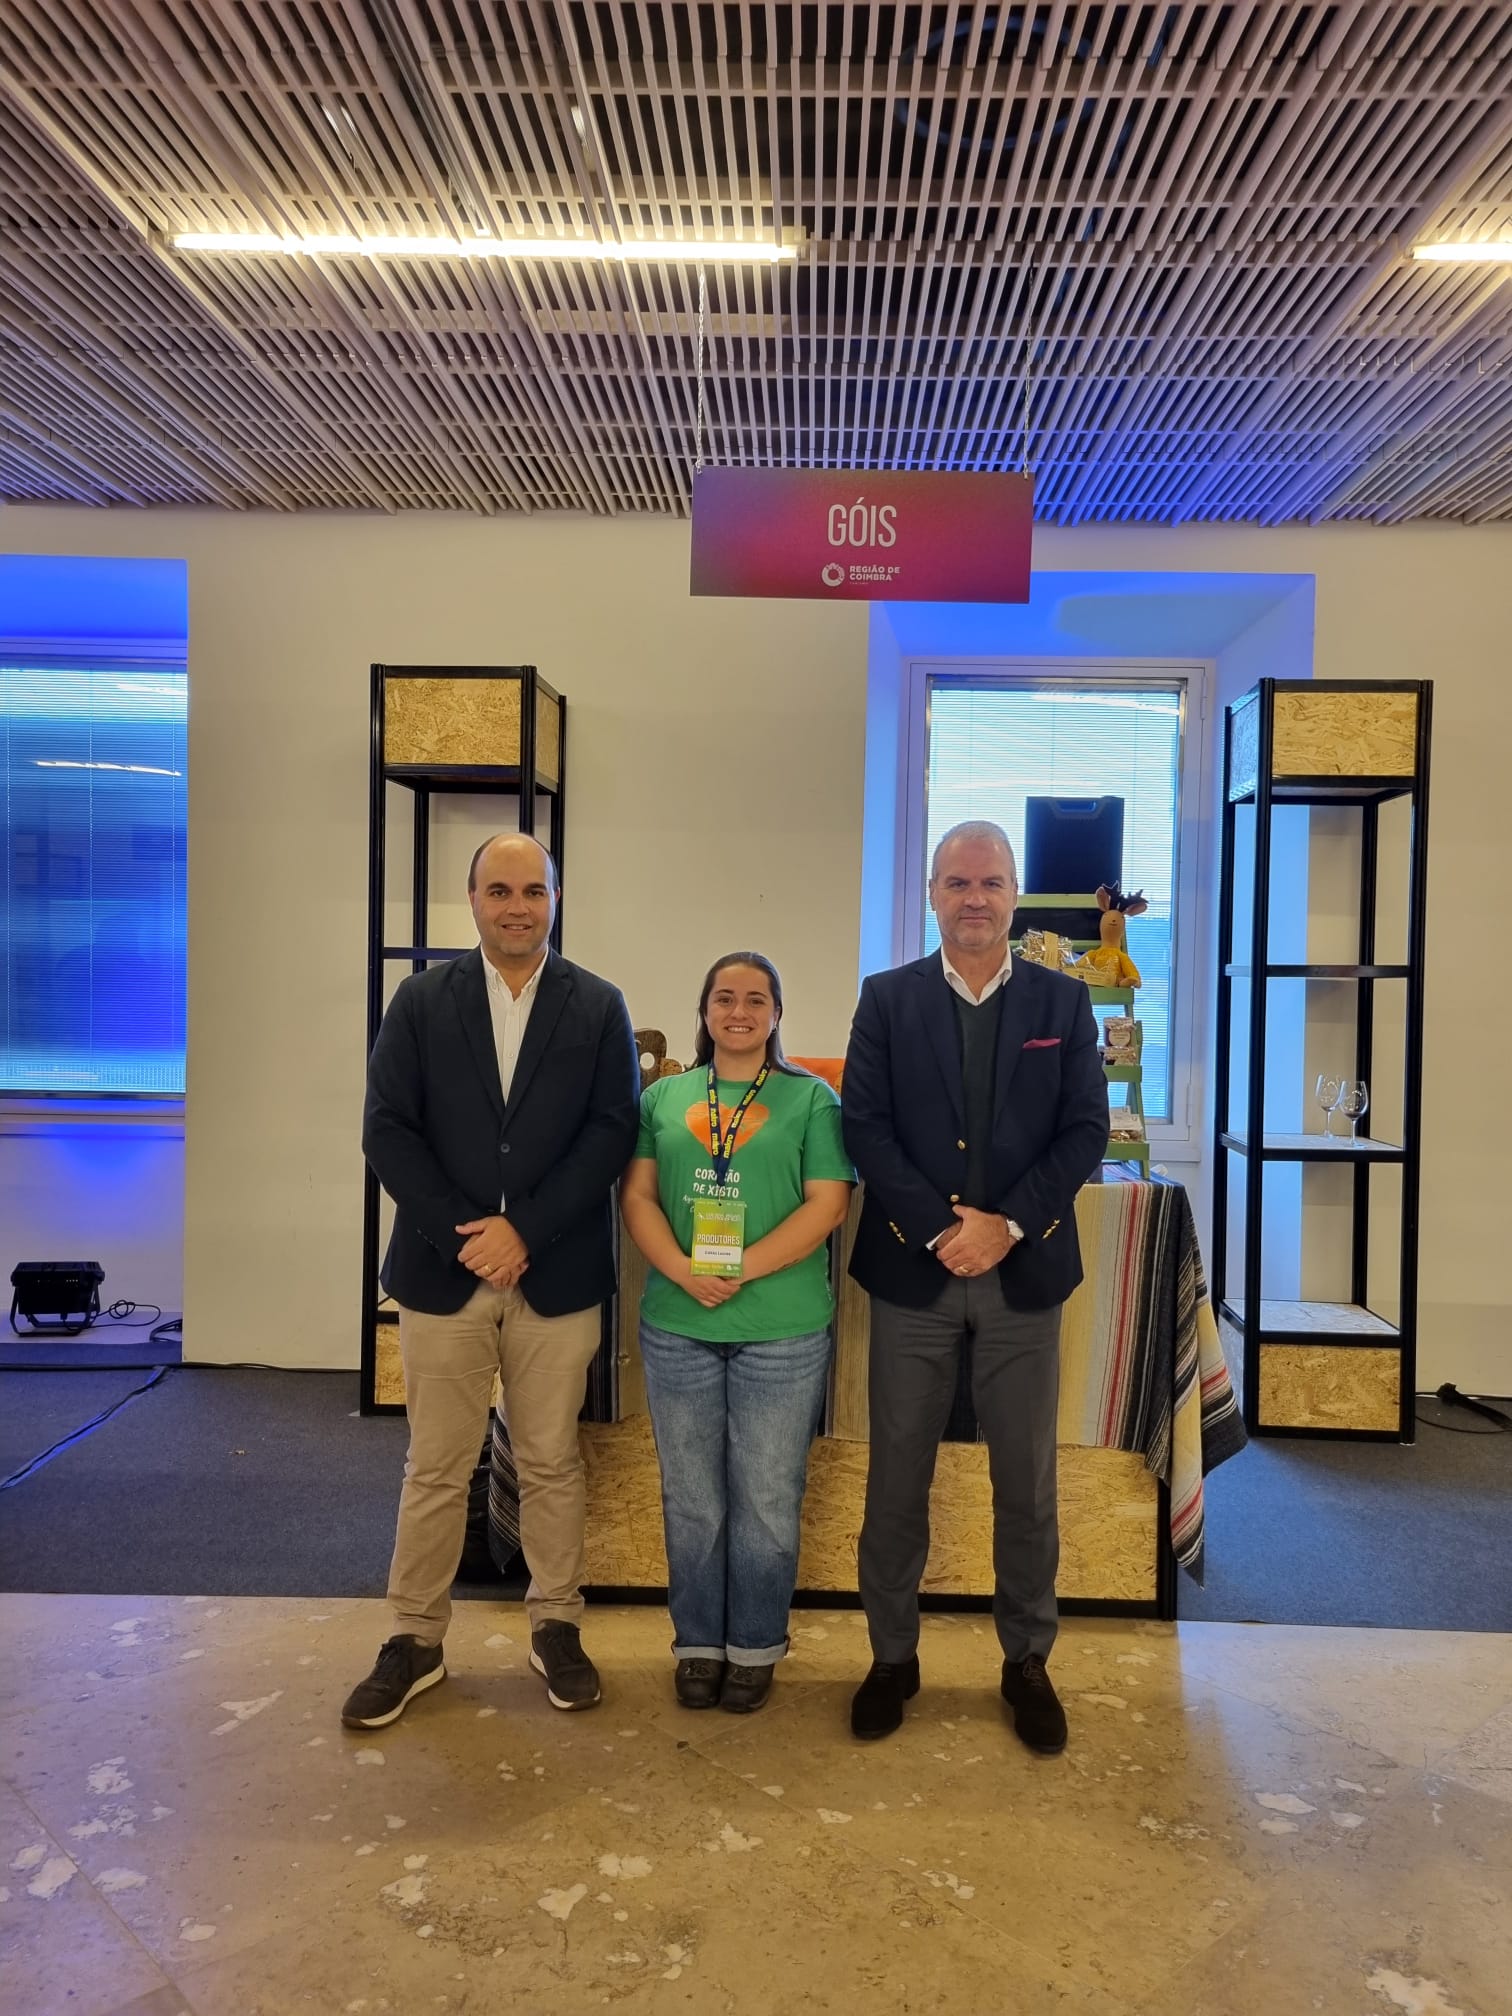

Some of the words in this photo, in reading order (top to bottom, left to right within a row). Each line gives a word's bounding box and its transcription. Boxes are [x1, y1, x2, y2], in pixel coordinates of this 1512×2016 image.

[828, 496, 897, 547] GÓIS
[849, 564, 885, 573] REGIÃO
[887, 566, 901, 574] DE
[849, 573, 892, 581] COIMBRA
[693, 1182, 706, 1194] DE
[707, 1184, 740, 1198] XISTO
[696, 1233, 740, 1245] PRODUTORES
